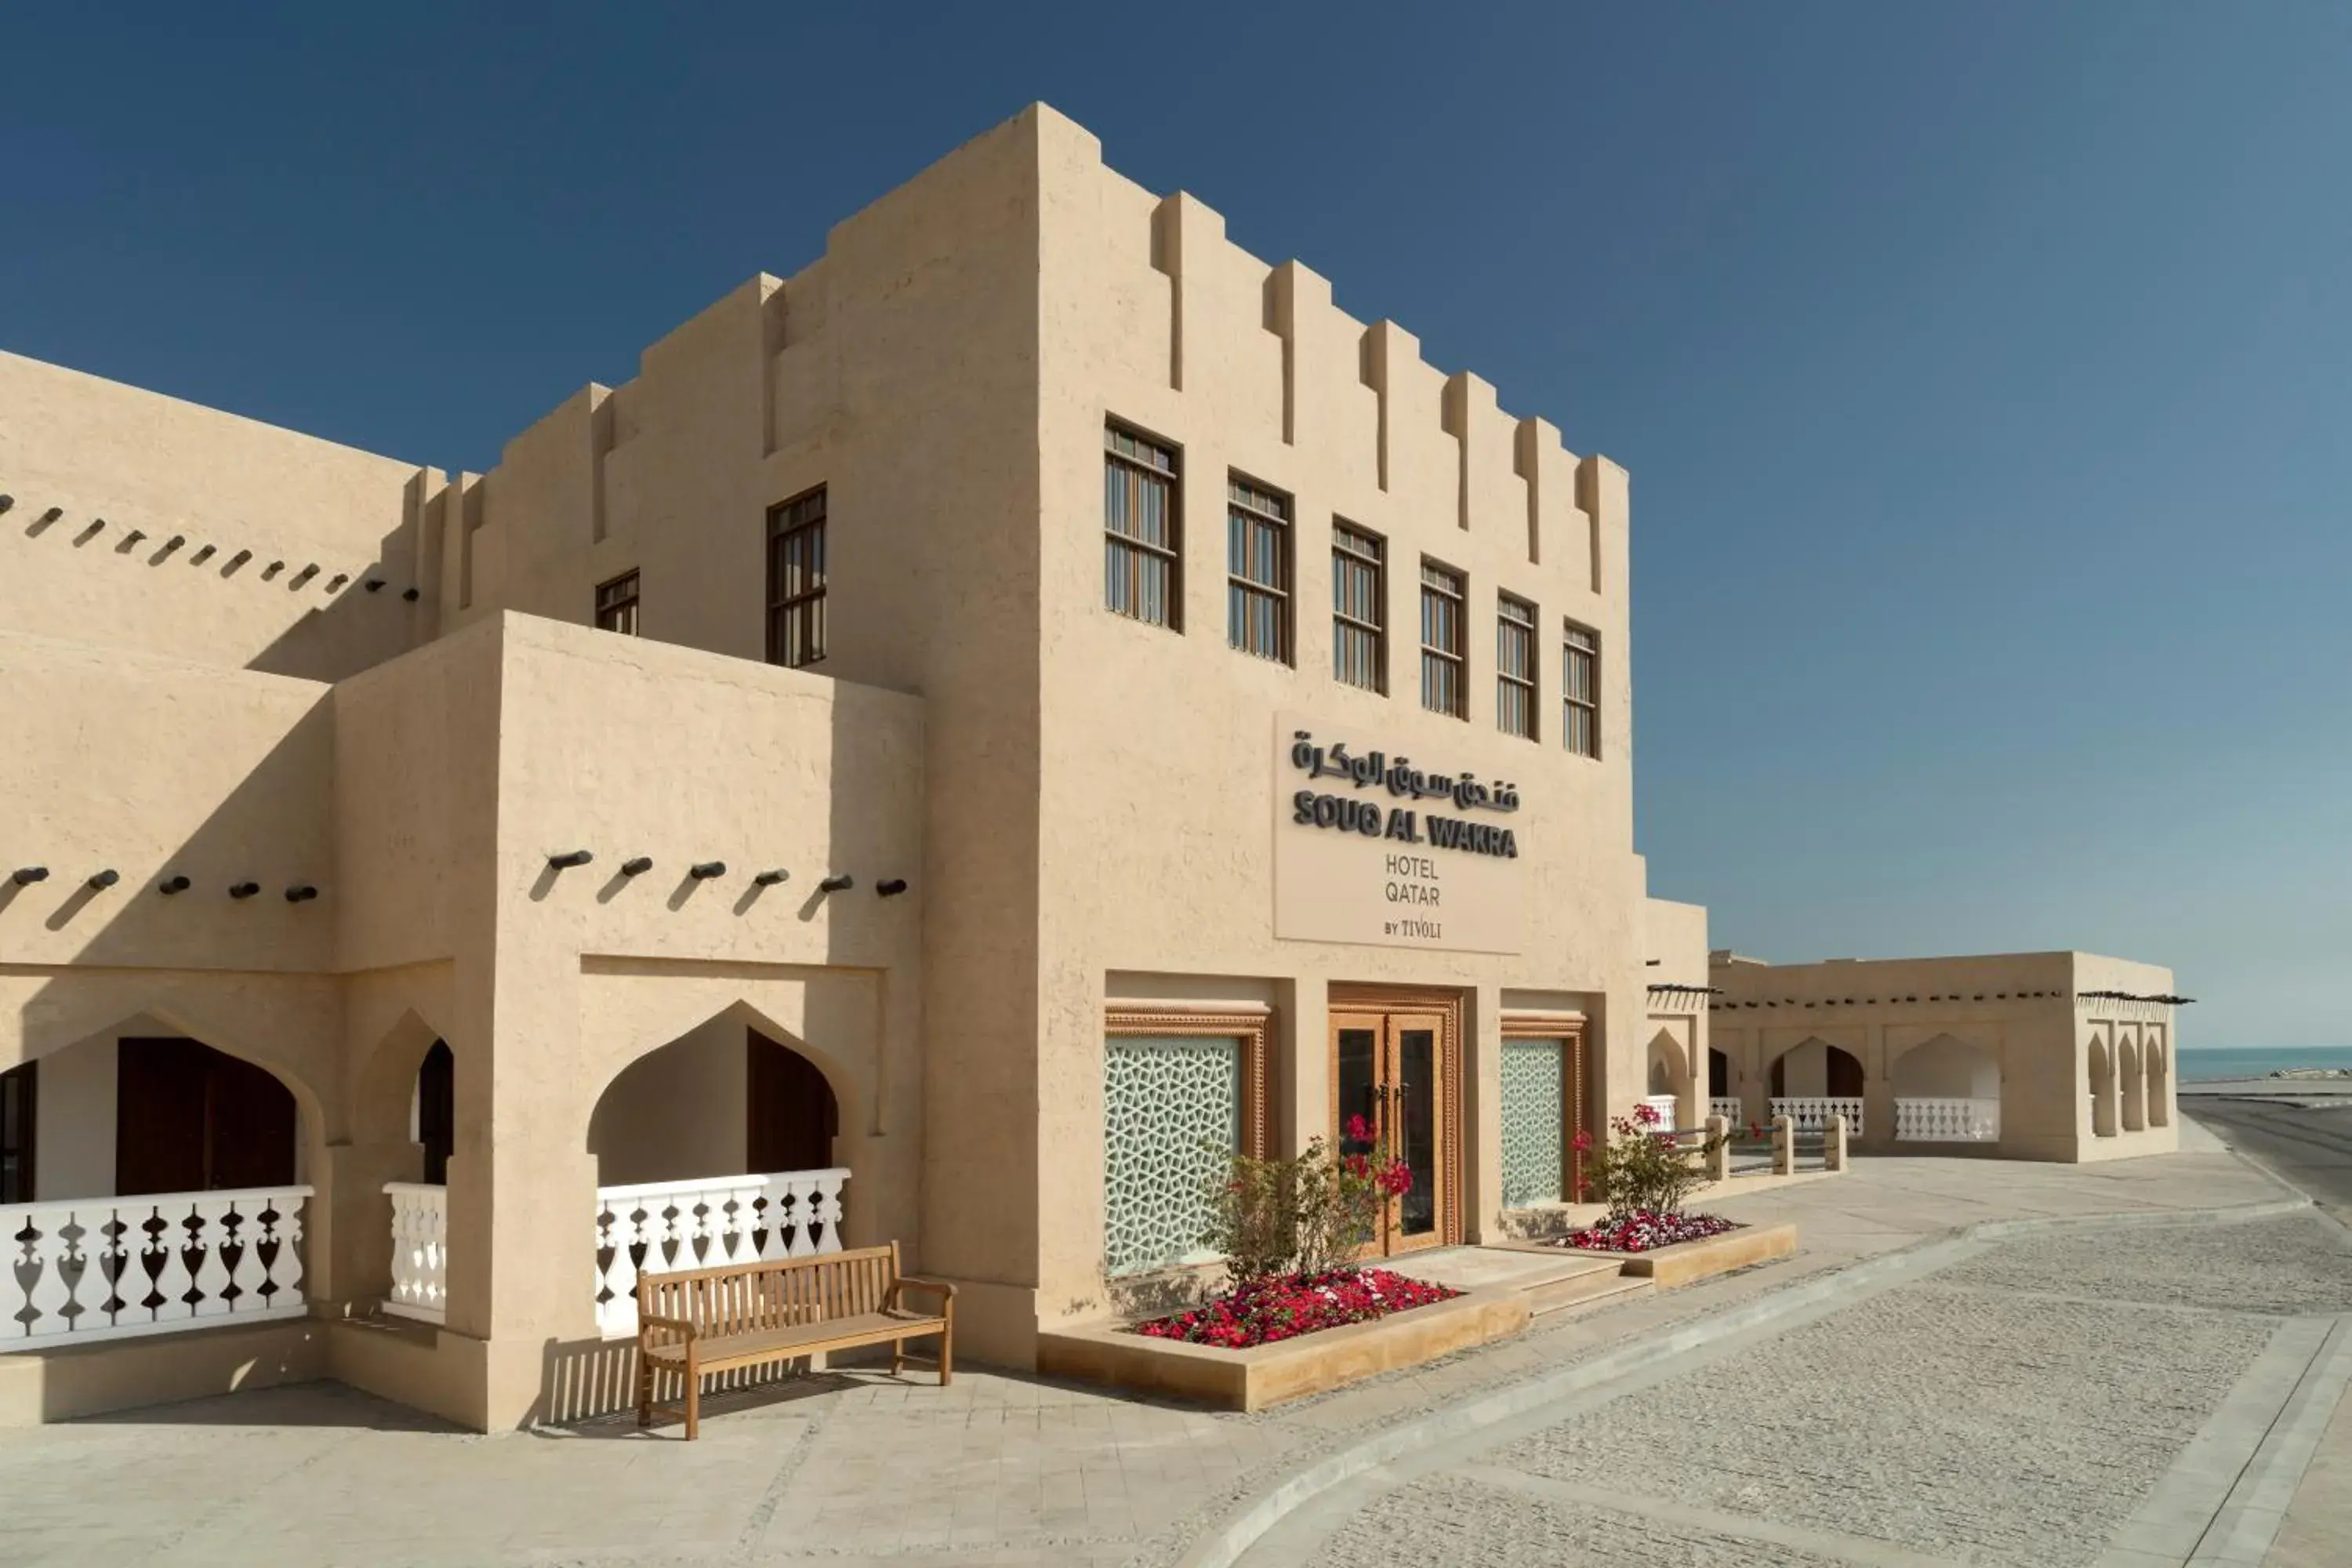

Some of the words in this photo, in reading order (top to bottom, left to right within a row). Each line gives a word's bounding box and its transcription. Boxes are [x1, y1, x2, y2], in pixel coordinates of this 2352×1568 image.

[1292, 731, 1385, 788] الوكرة
[1387, 757, 1452, 800] سوق
[1454, 773, 1519, 812] فندق
[1293, 790, 1382, 837] SOUQ
[1385, 808, 1425, 843] AL
[1427, 815, 1518, 858] WAKRA
[1386, 854, 1439, 880] HOTEL
[1385, 882, 1439, 906] QATAR
[1385, 922, 1399, 935] BY
[1402, 915, 1441, 938] TIVOLI
